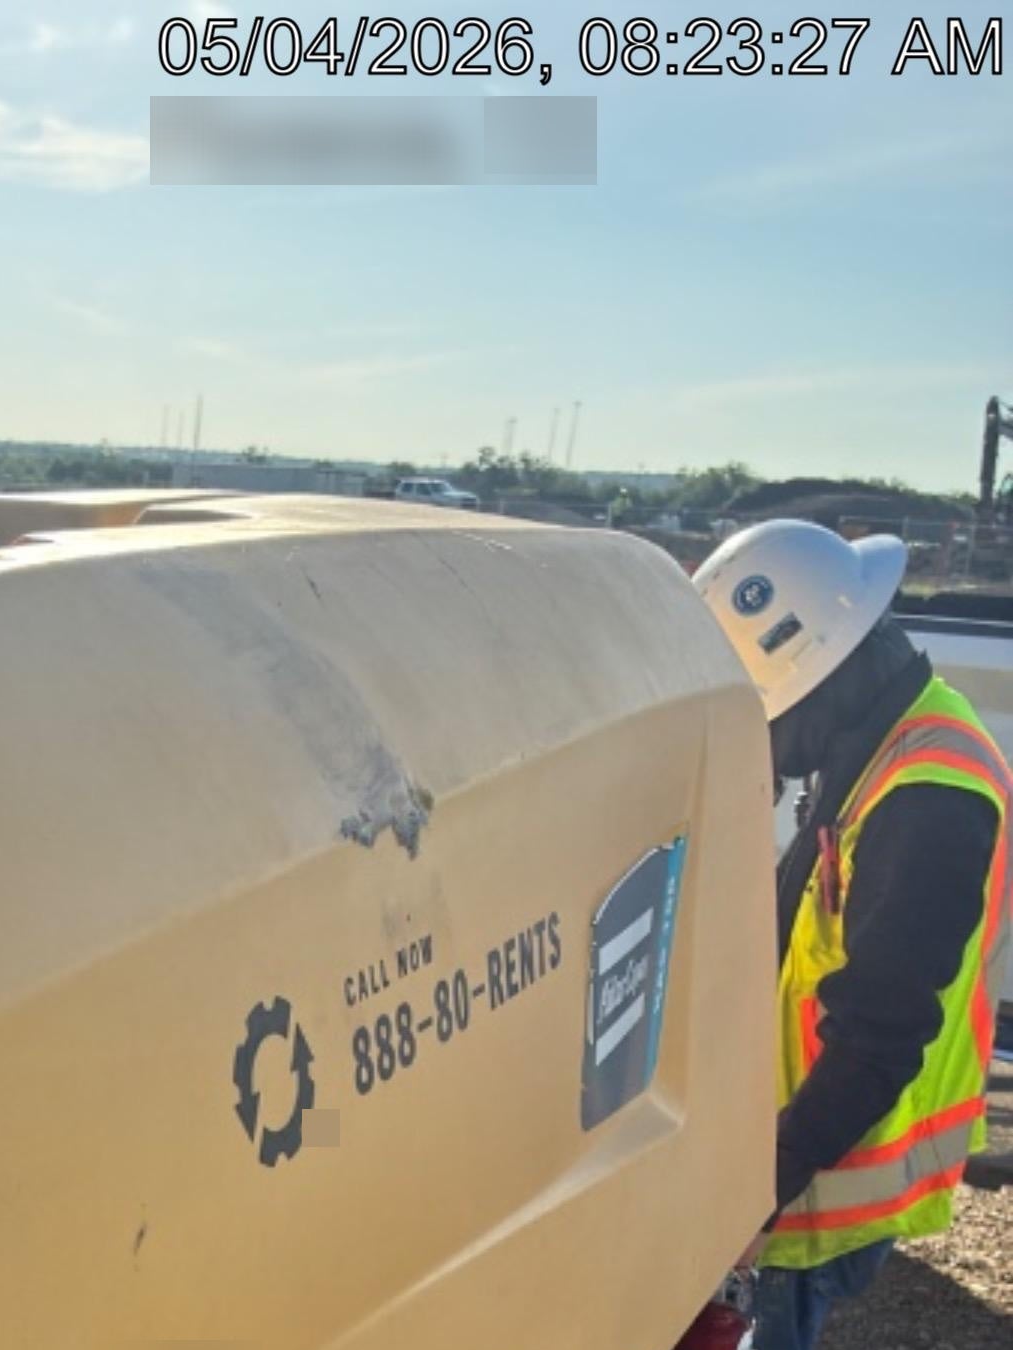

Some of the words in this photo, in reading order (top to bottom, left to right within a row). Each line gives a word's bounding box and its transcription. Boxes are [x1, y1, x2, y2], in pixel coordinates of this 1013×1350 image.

[343, 959, 390, 1007] CALL
[396, 934, 433, 978] NOW
[352, 912, 563, 1096] 888-80-RENTS
